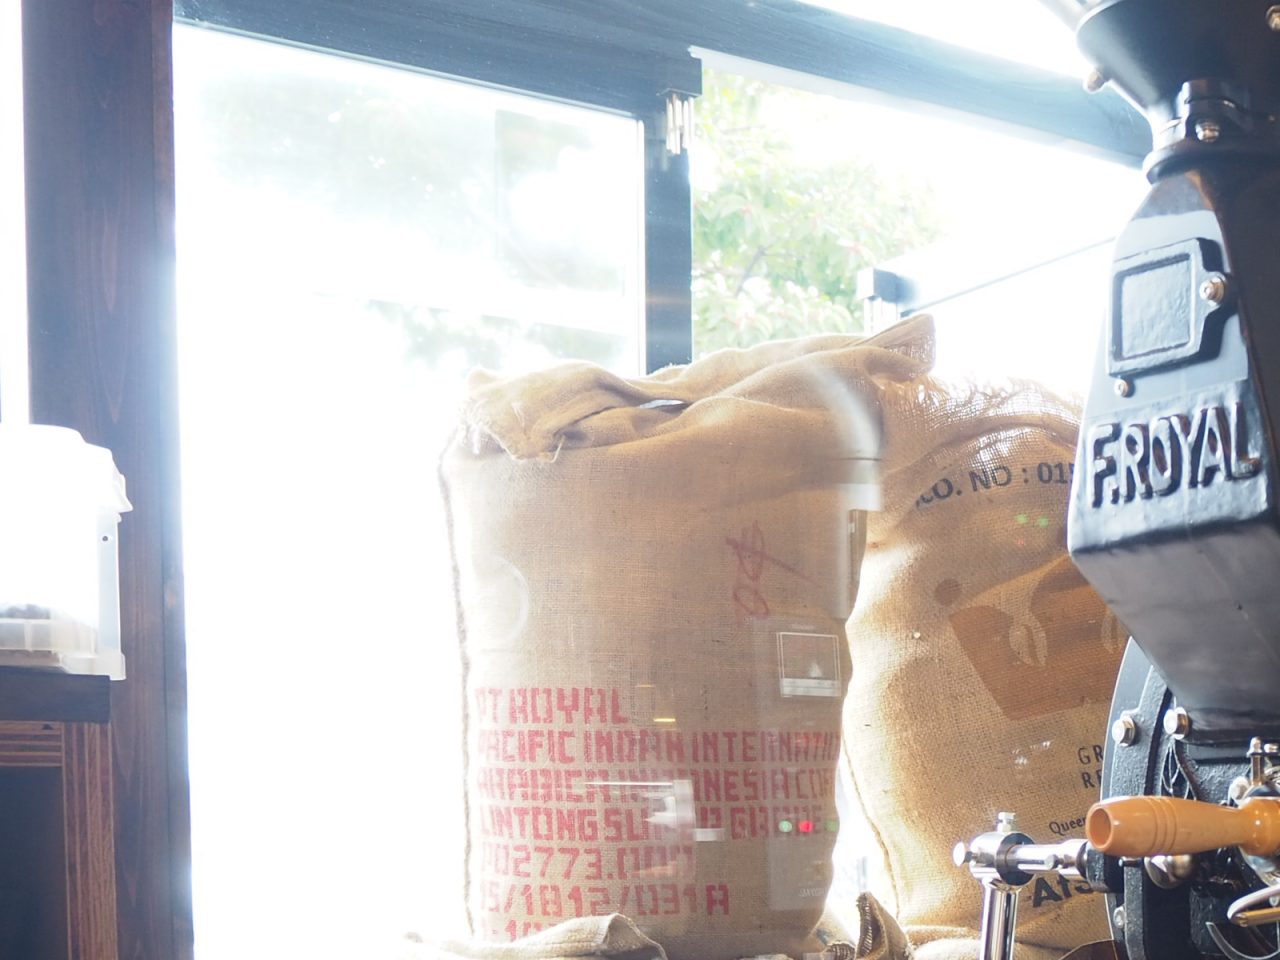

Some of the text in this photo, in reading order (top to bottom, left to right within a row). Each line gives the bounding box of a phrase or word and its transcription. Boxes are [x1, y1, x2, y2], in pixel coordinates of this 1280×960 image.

[1087, 402, 1263, 508] F.ROYAL
[969, 465, 1012, 492] NO
[510, 687, 629, 724] ROYAL
